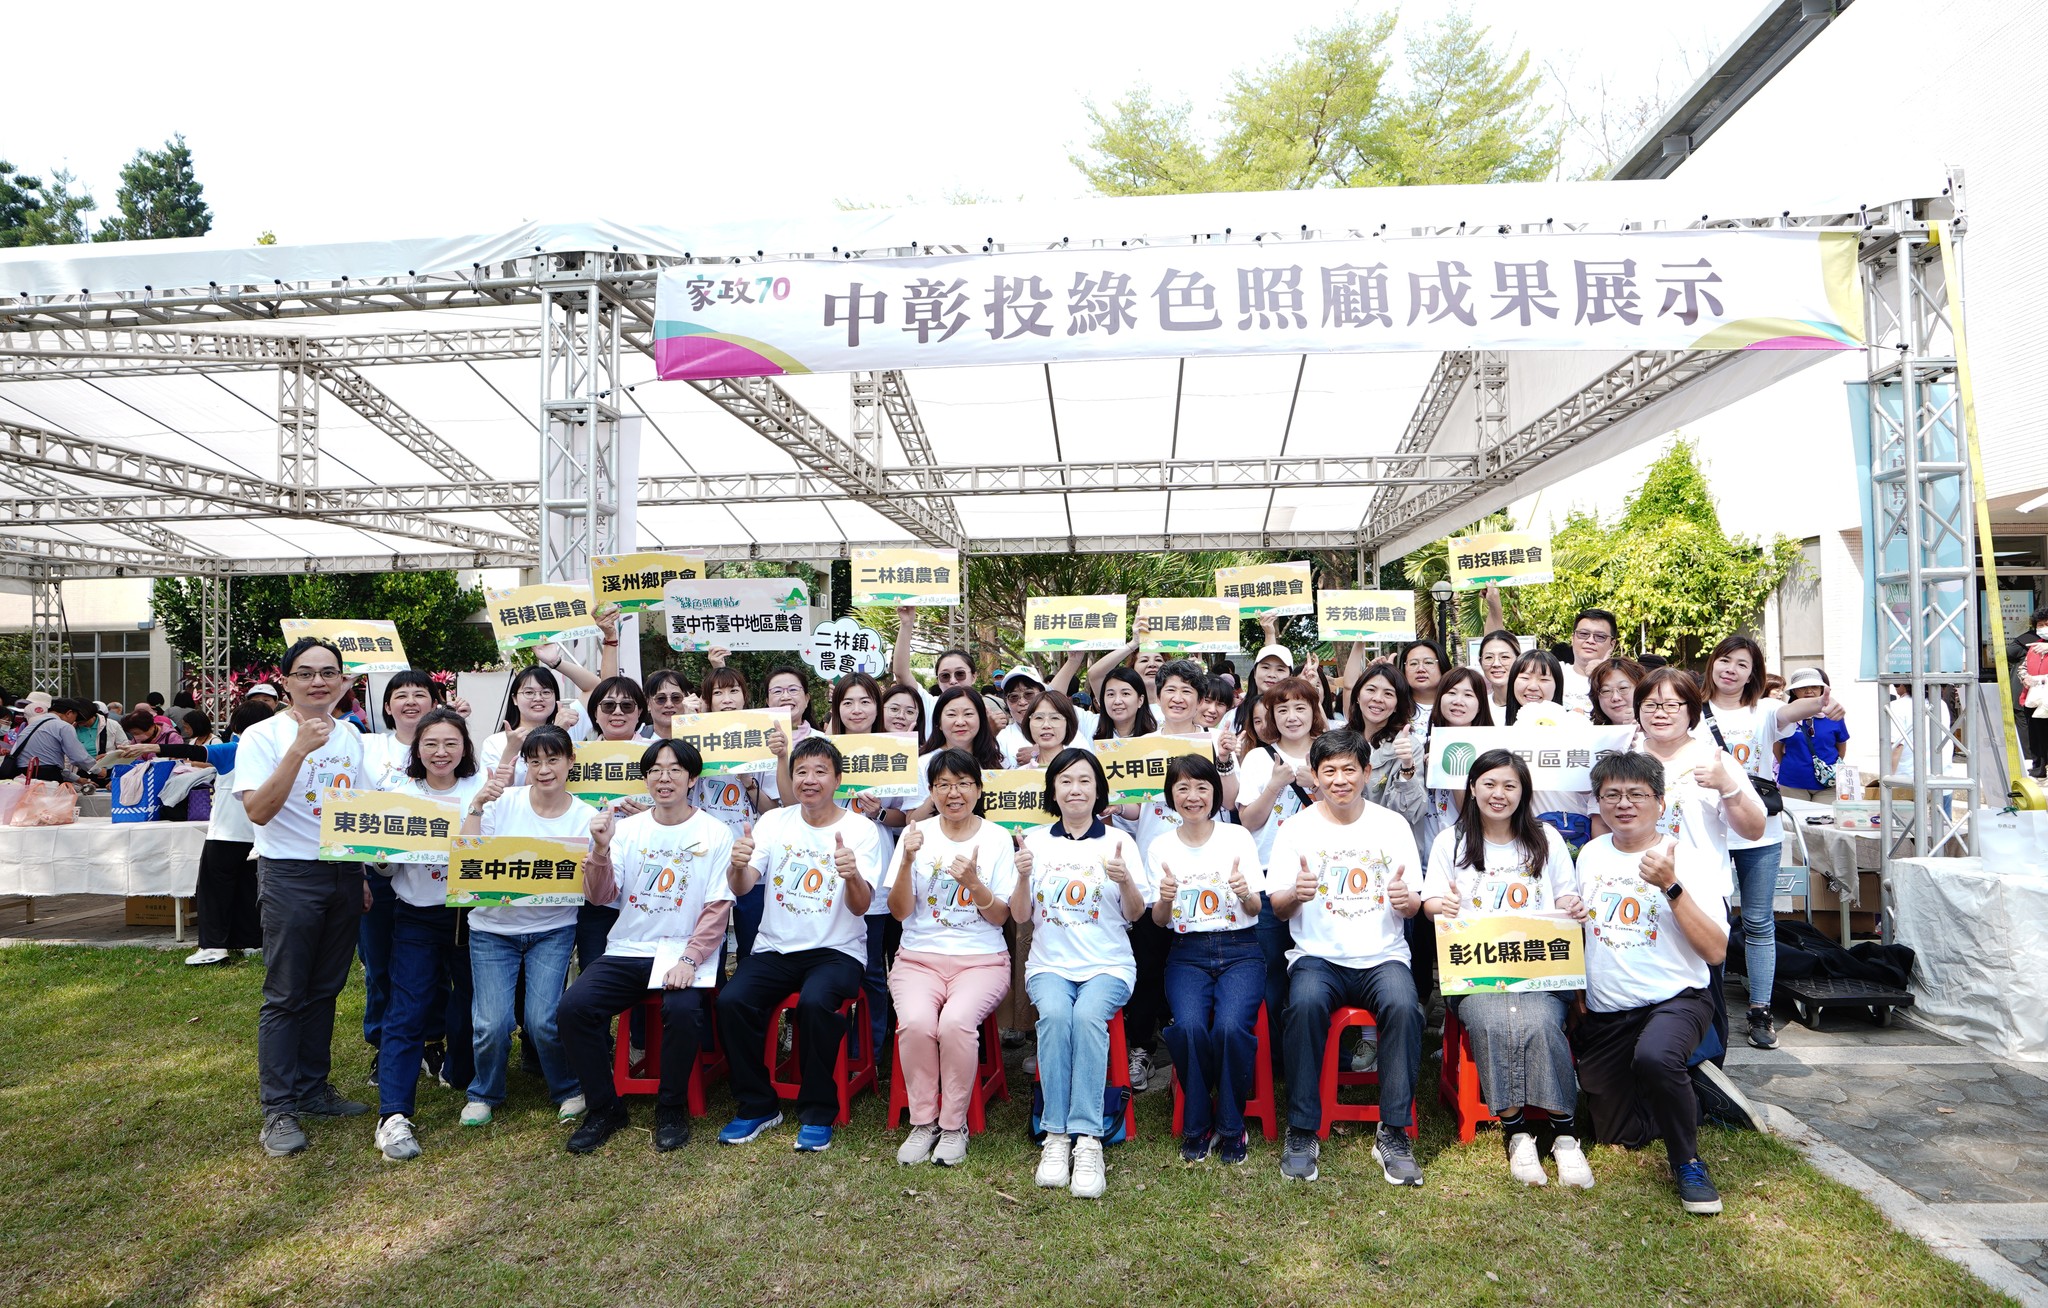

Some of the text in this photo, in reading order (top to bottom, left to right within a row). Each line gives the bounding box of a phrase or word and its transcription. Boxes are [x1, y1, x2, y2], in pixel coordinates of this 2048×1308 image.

[823, 257, 1726, 348] 中彰投綠色照顧成果展示
[1457, 546, 1543, 570] 南投縣農會
[861, 566, 950, 584] 二林鎮農會
[1223, 578, 1304, 599] 福興鄉農會
[499, 598, 588, 627] 梧棲區農會
[1033, 612, 1118, 631] 龍井區農會
[1149, 614, 1232, 632] 田尾鄉農會
[1325, 606, 1407, 622] 芳苑鄉農會
[671, 613, 804, 635] 臺中市臺中地區農會
[815, 630, 869, 652] 二林鎮
[820, 651, 856, 674] 農會
[333, 811, 450, 838] 東勢區農會
[459, 859, 578, 880] 臺中市農會
[1449, 937, 1571, 966] 彰化縣農會
